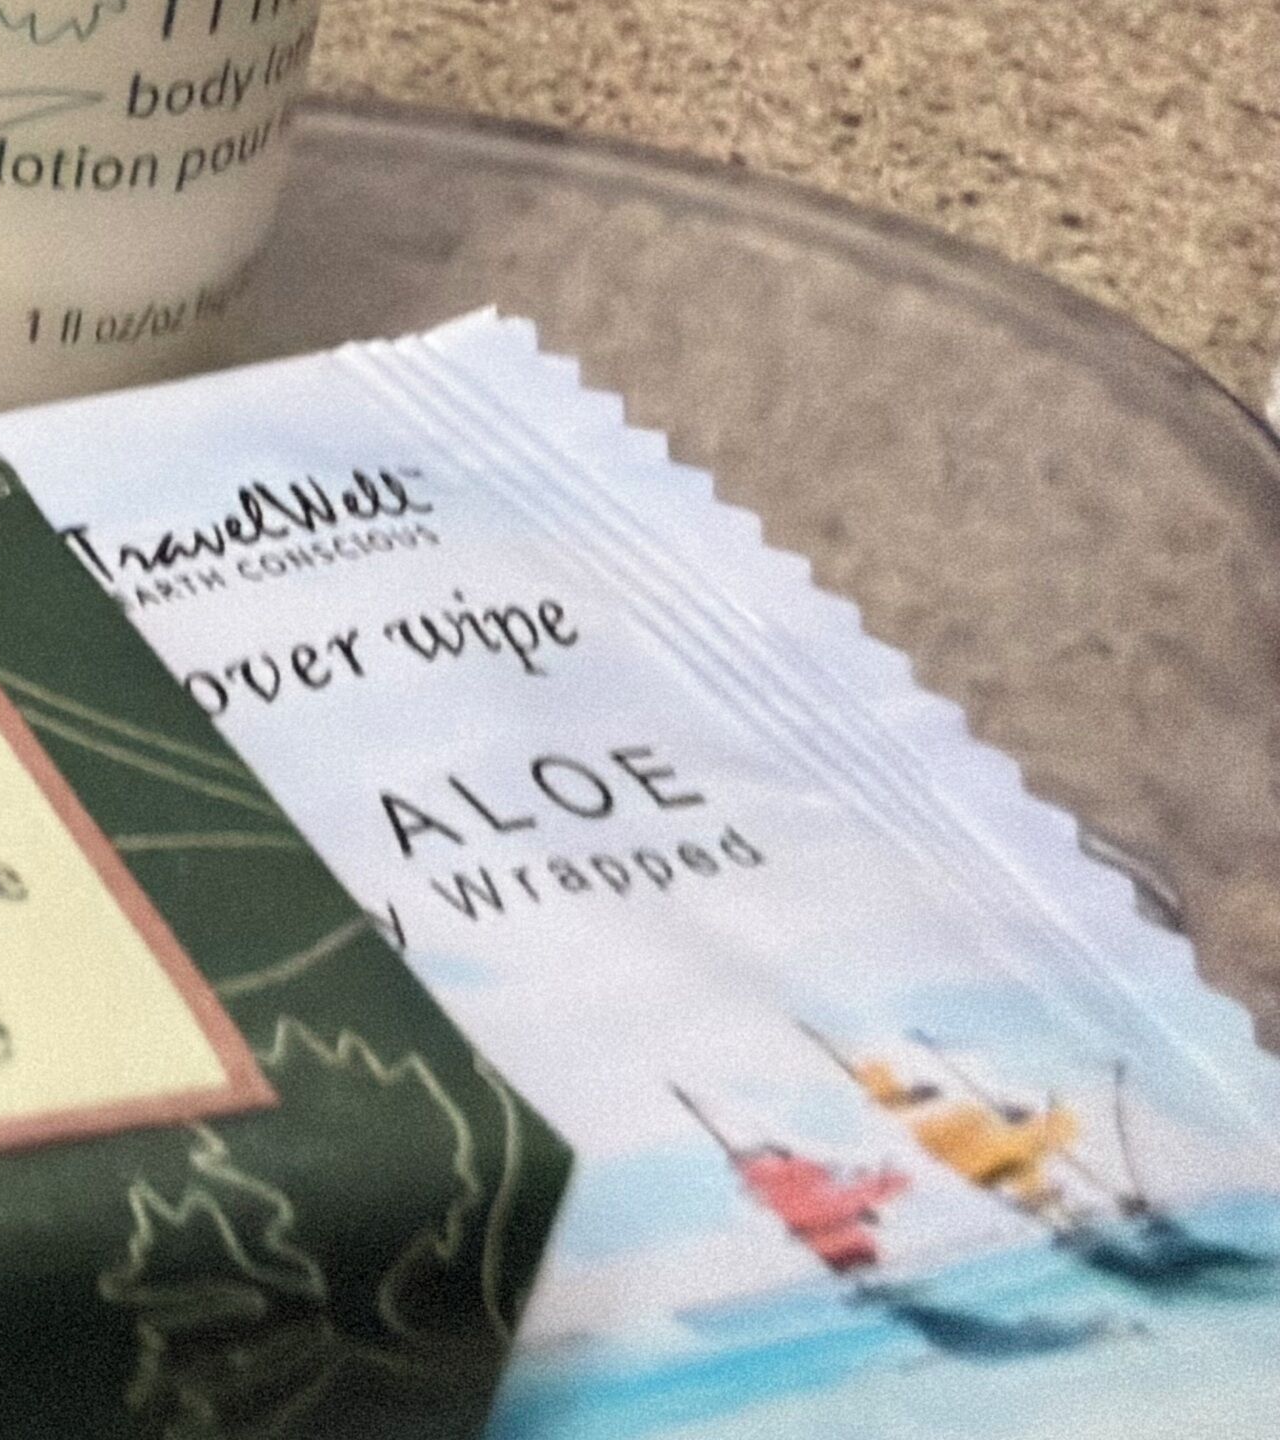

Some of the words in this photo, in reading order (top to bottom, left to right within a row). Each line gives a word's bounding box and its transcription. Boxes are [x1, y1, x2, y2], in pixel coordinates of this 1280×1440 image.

[127, 58, 254, 119] body
[175, 120, 272, 193] pour
[27, 308, 40, 344] 1
[59, 467, 433, 583] TravelWell
[236, 520, 440, 583] CONSCIOUS
[383, 588, 580, 677] wipe
[378, 744, 708, 857] ALOE
[430, 824, 767, 924] Wrapped
